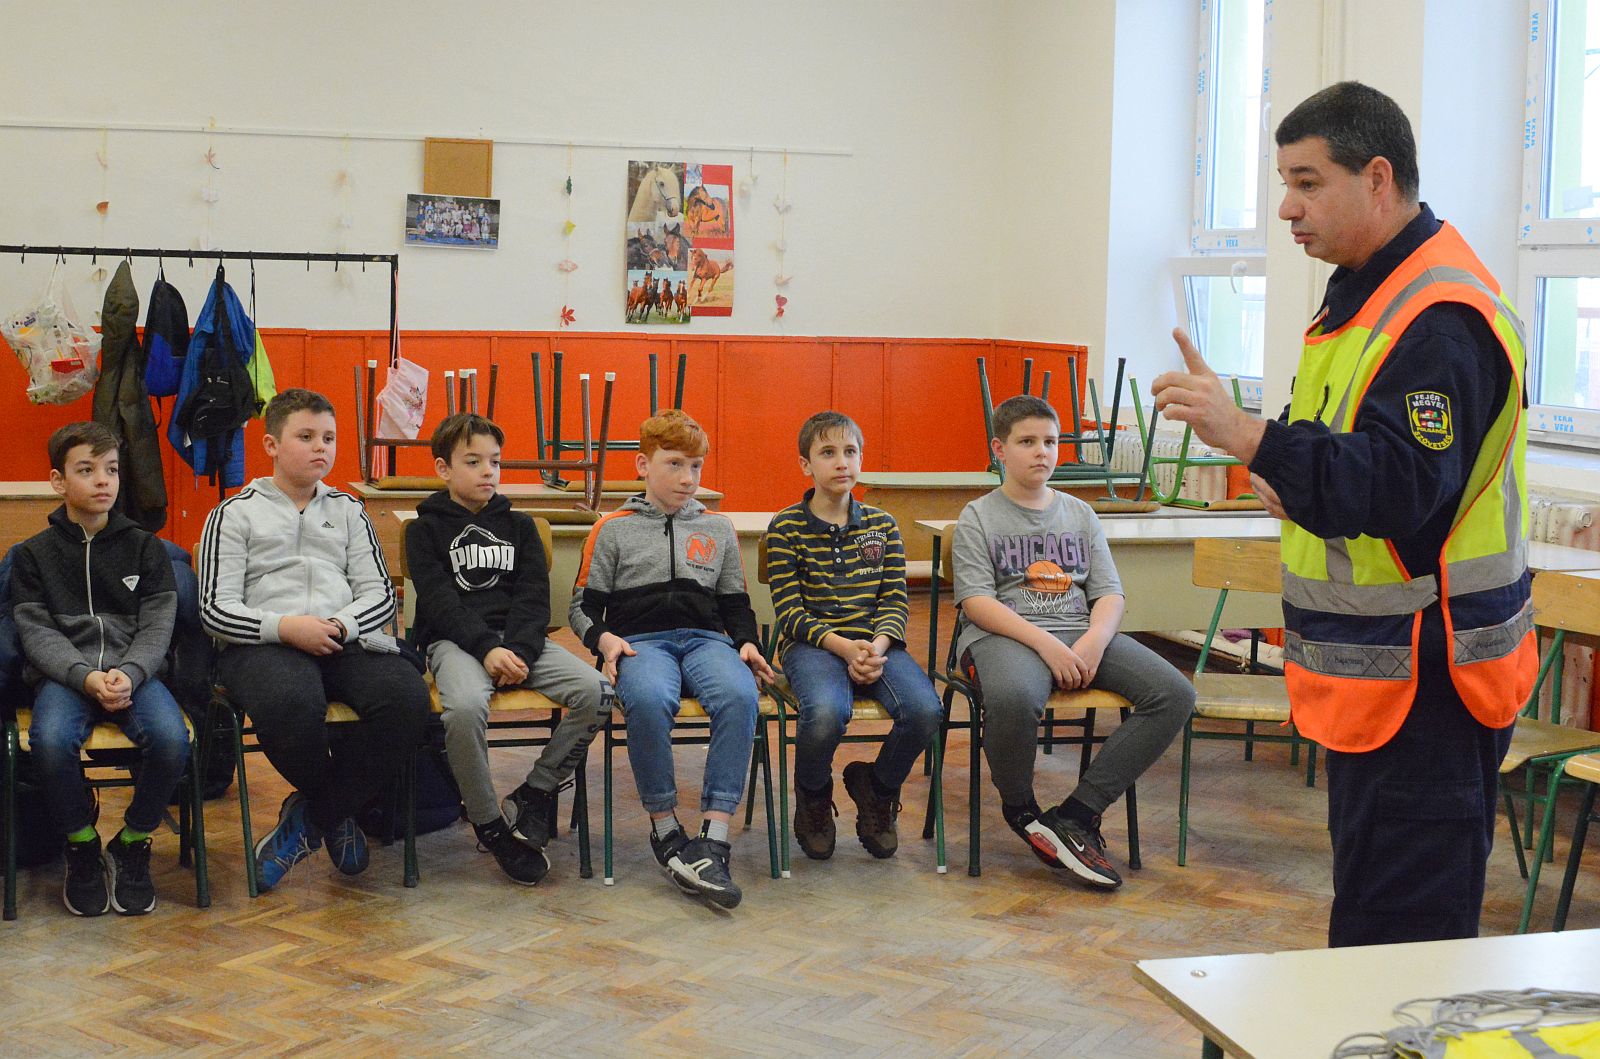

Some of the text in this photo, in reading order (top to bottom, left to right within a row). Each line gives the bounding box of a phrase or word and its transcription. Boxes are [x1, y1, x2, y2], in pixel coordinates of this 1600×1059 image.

[1226, 239, 1238, 248] VEKA
[1554, 423, 1574, 433] VEKA
[449, 544, 515, 573] PUMA
[989, 530, 1091, 571] CHICAGO
